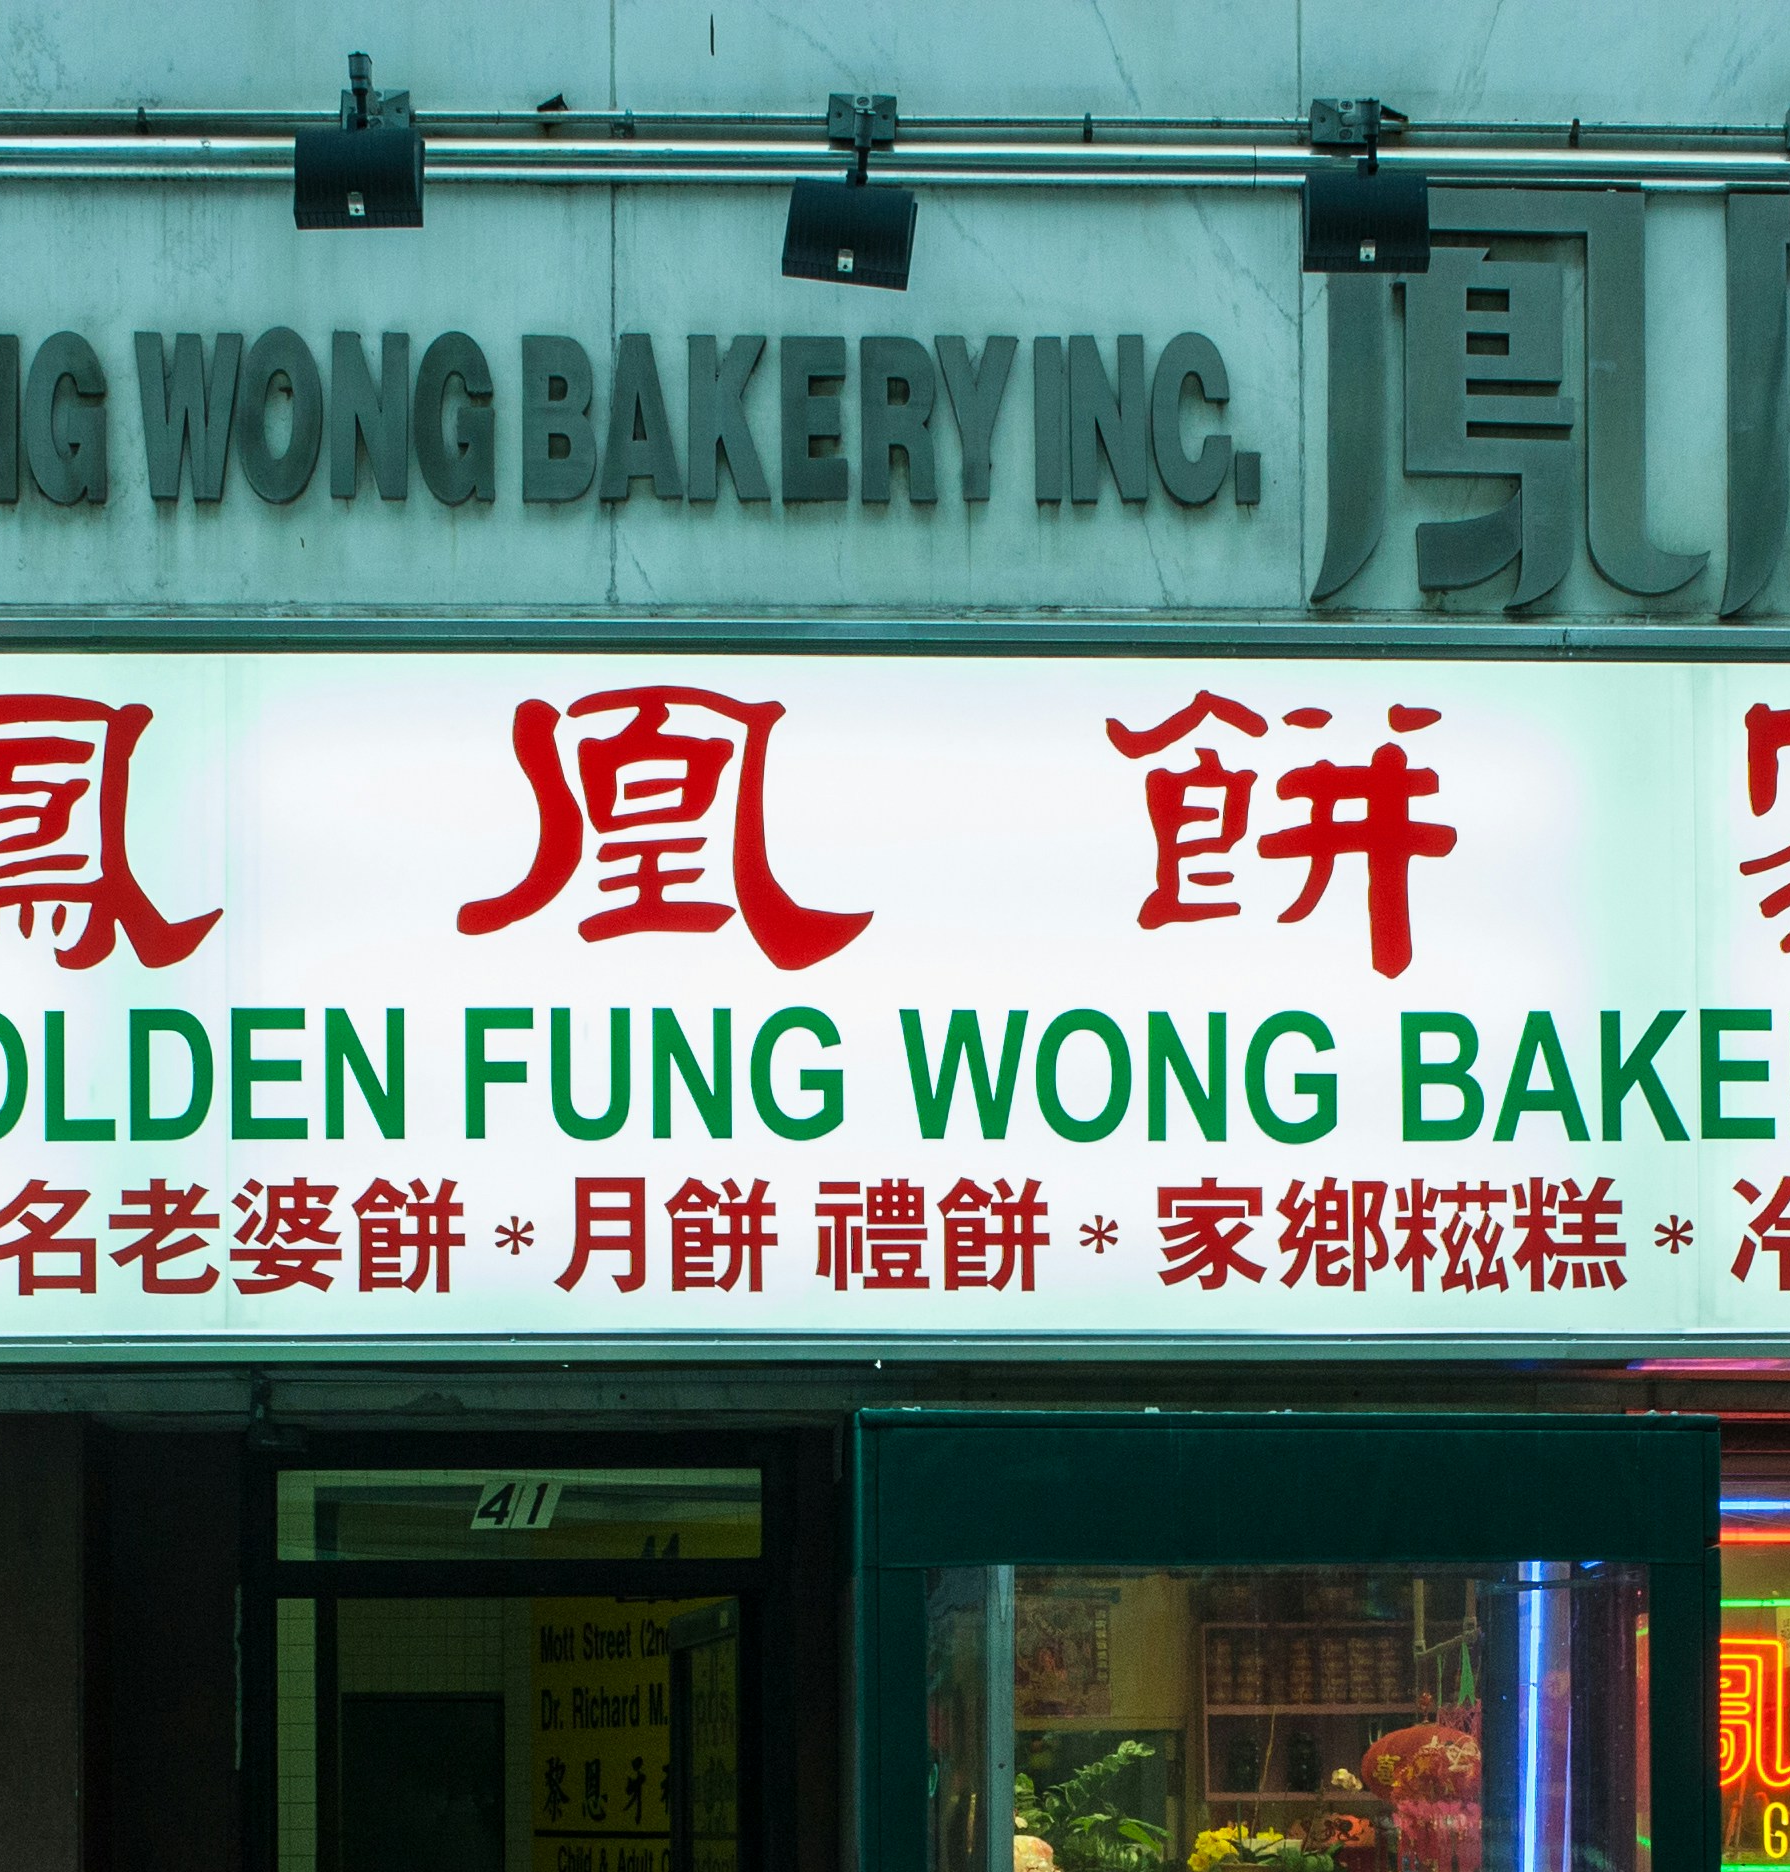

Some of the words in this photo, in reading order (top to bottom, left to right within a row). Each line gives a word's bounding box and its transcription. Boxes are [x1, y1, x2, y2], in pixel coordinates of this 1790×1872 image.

[135, 325, 496, 504] WONG
[523, 332, 1017, 504] BAKERY
[1033, 330, 1262, 506] INC.
[465, 1007, 843, 1141] FUNG
[899, 1009, 1337, 1144] WONG
[553, 1176, 780, 1296] 月餅
[815, 1176, 1051, 1293] 禮餅
[476, 1483, 550, 1527] 41
[541, 1626, 574, 1663] Mott
[583, 1622, 632, 1660] Street
[541, 1689, 563, 1730] Dr.
[572, 1685, 640, 1728] Richard
